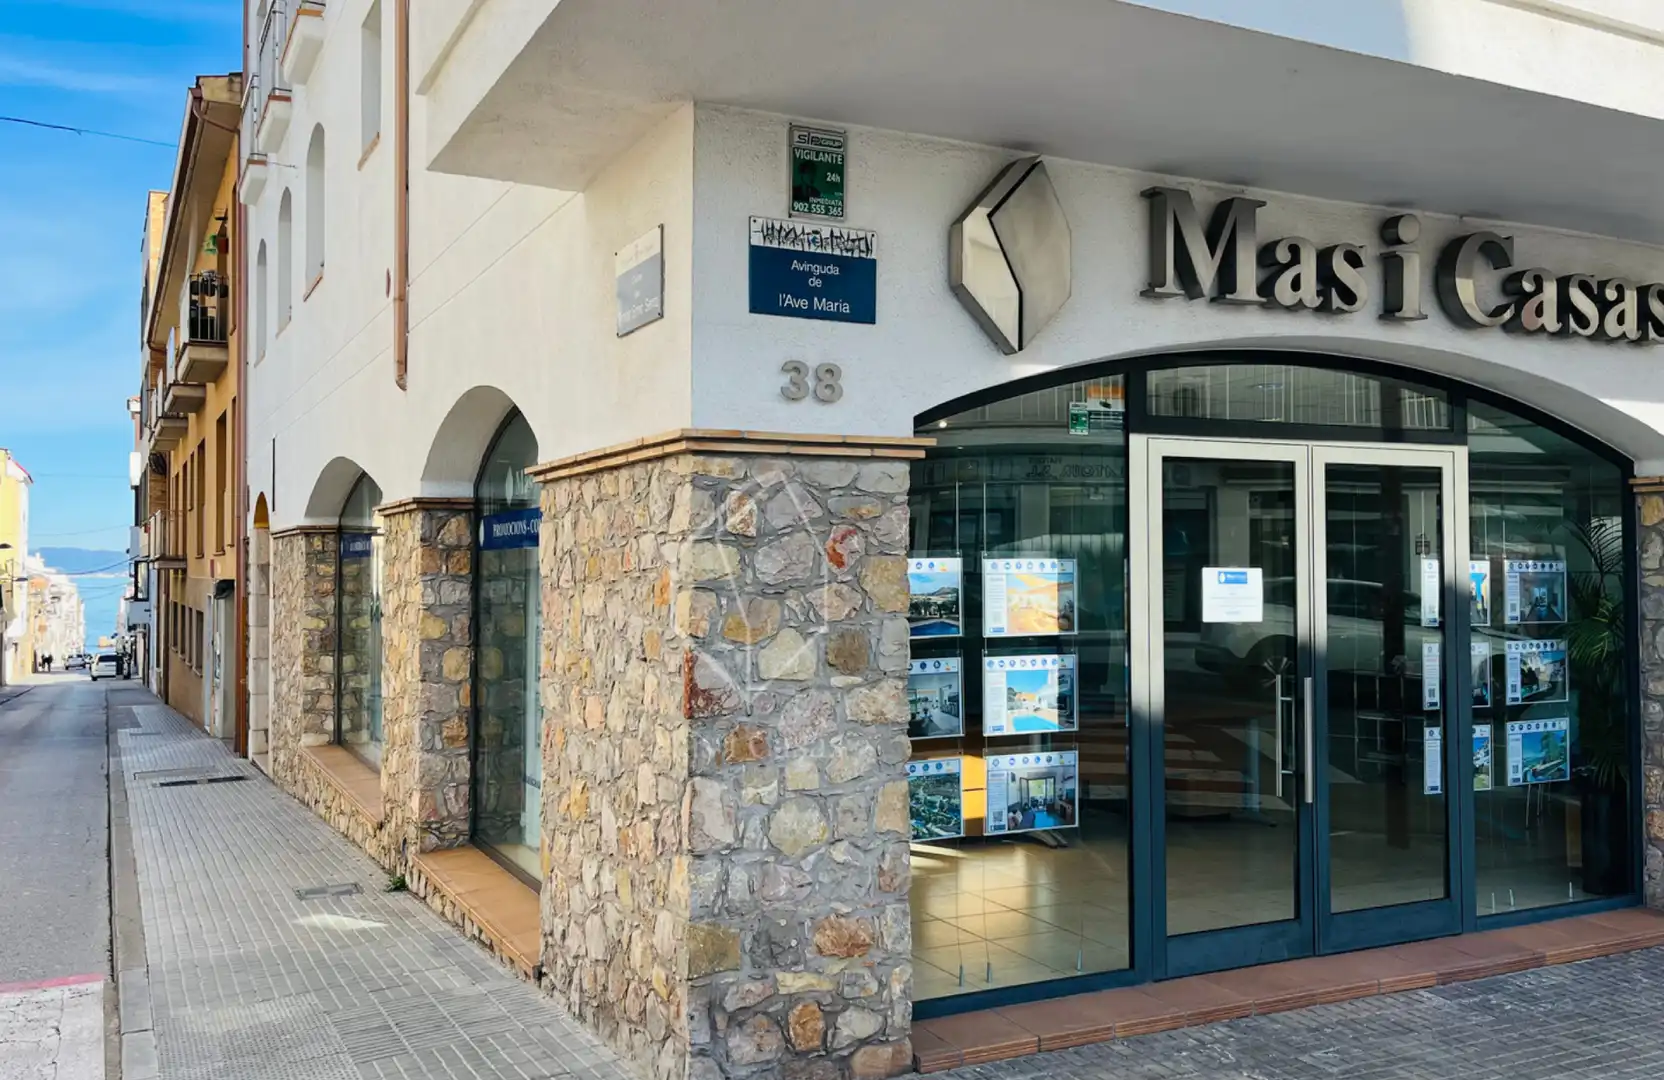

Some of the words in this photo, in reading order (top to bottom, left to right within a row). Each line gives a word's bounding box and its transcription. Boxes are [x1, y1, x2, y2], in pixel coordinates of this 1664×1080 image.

[794, 148, 843, 164] VIGILANTE
[826, 172, 841, 183] 24h
[793, 201, 809, 212] 902
[811, 203, 826, 214] 555
[828, 206, 843, 216] 365
[791, 259, 840, 275] Avinguda
[808, 276, 822, 287] de
[779, 293, 809, 309] l'Ave
[813, 297, 851, 314] Maria
[780, 360, 844, 402] 38
